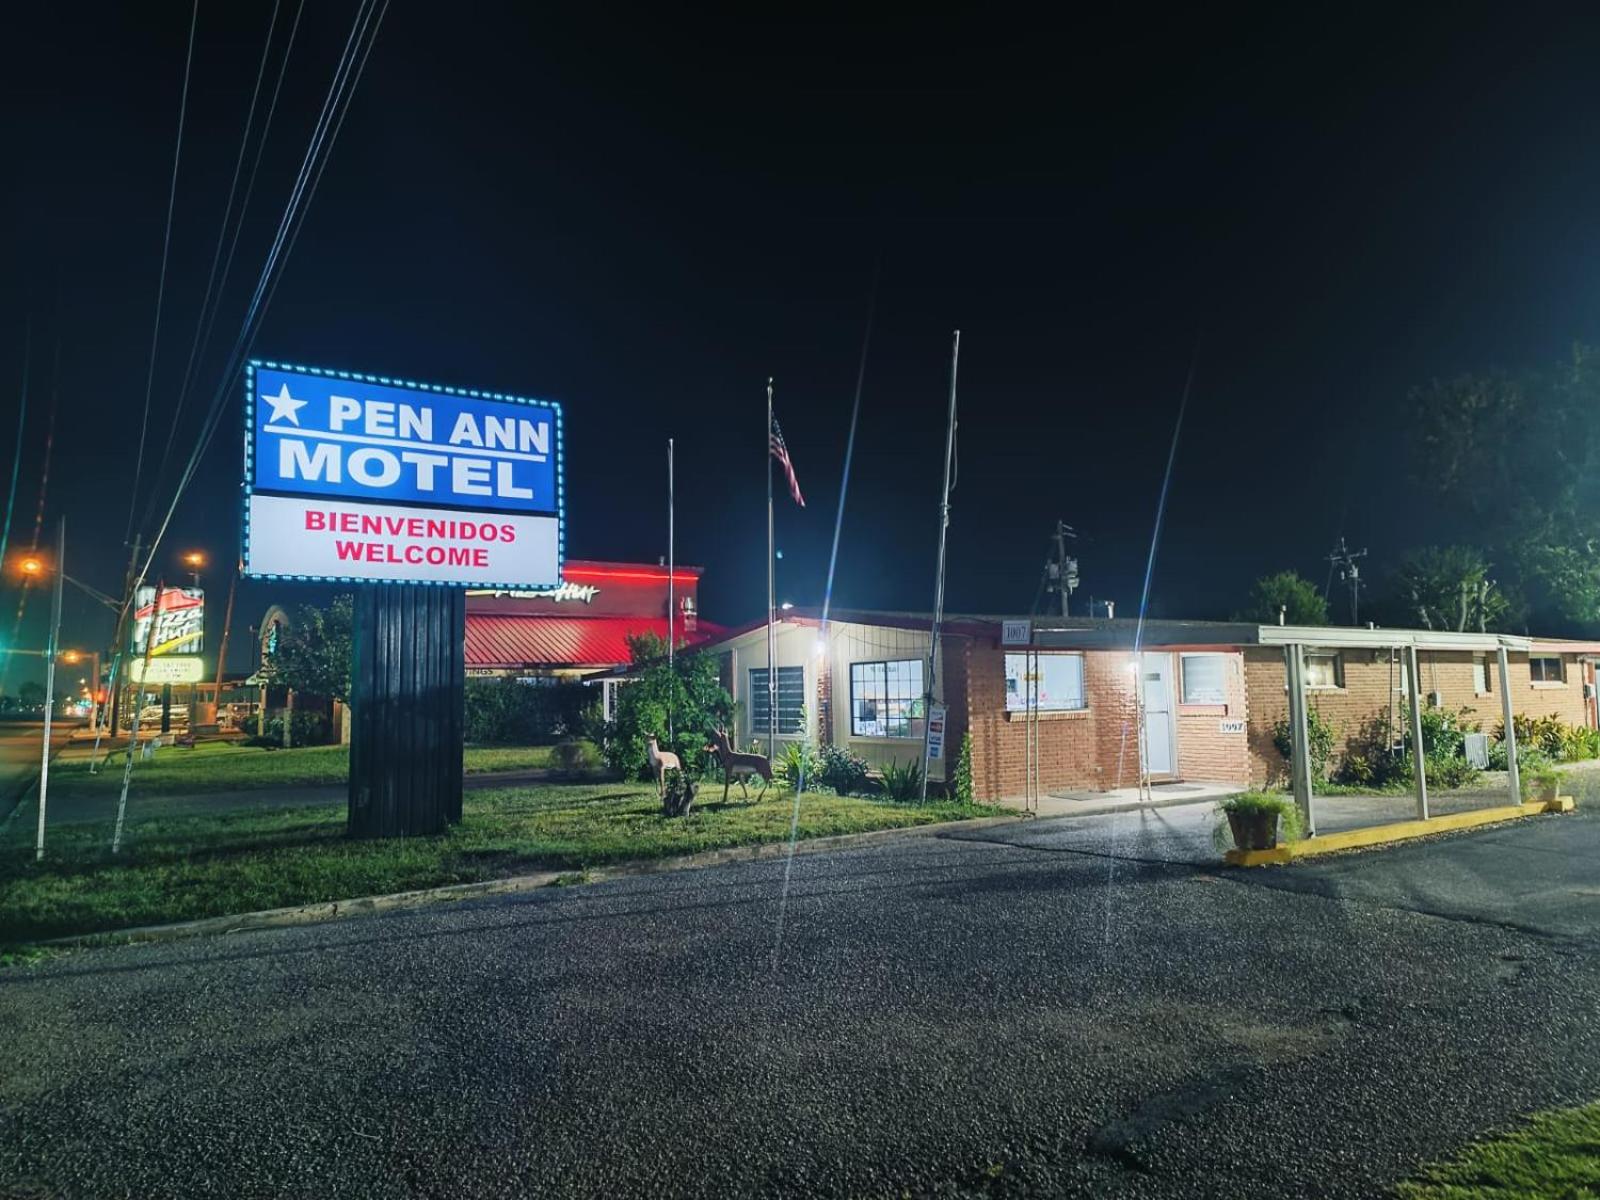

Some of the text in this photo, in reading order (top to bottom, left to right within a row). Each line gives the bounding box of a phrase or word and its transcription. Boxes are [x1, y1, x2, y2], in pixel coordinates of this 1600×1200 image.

[329, 395, 550, 455] PEN ANN
[278, 438, 535, 501] MOTEL
[304, 509, 516, 543] BIENVENIDOS
[335, 540, 490, 567] WELCOME
